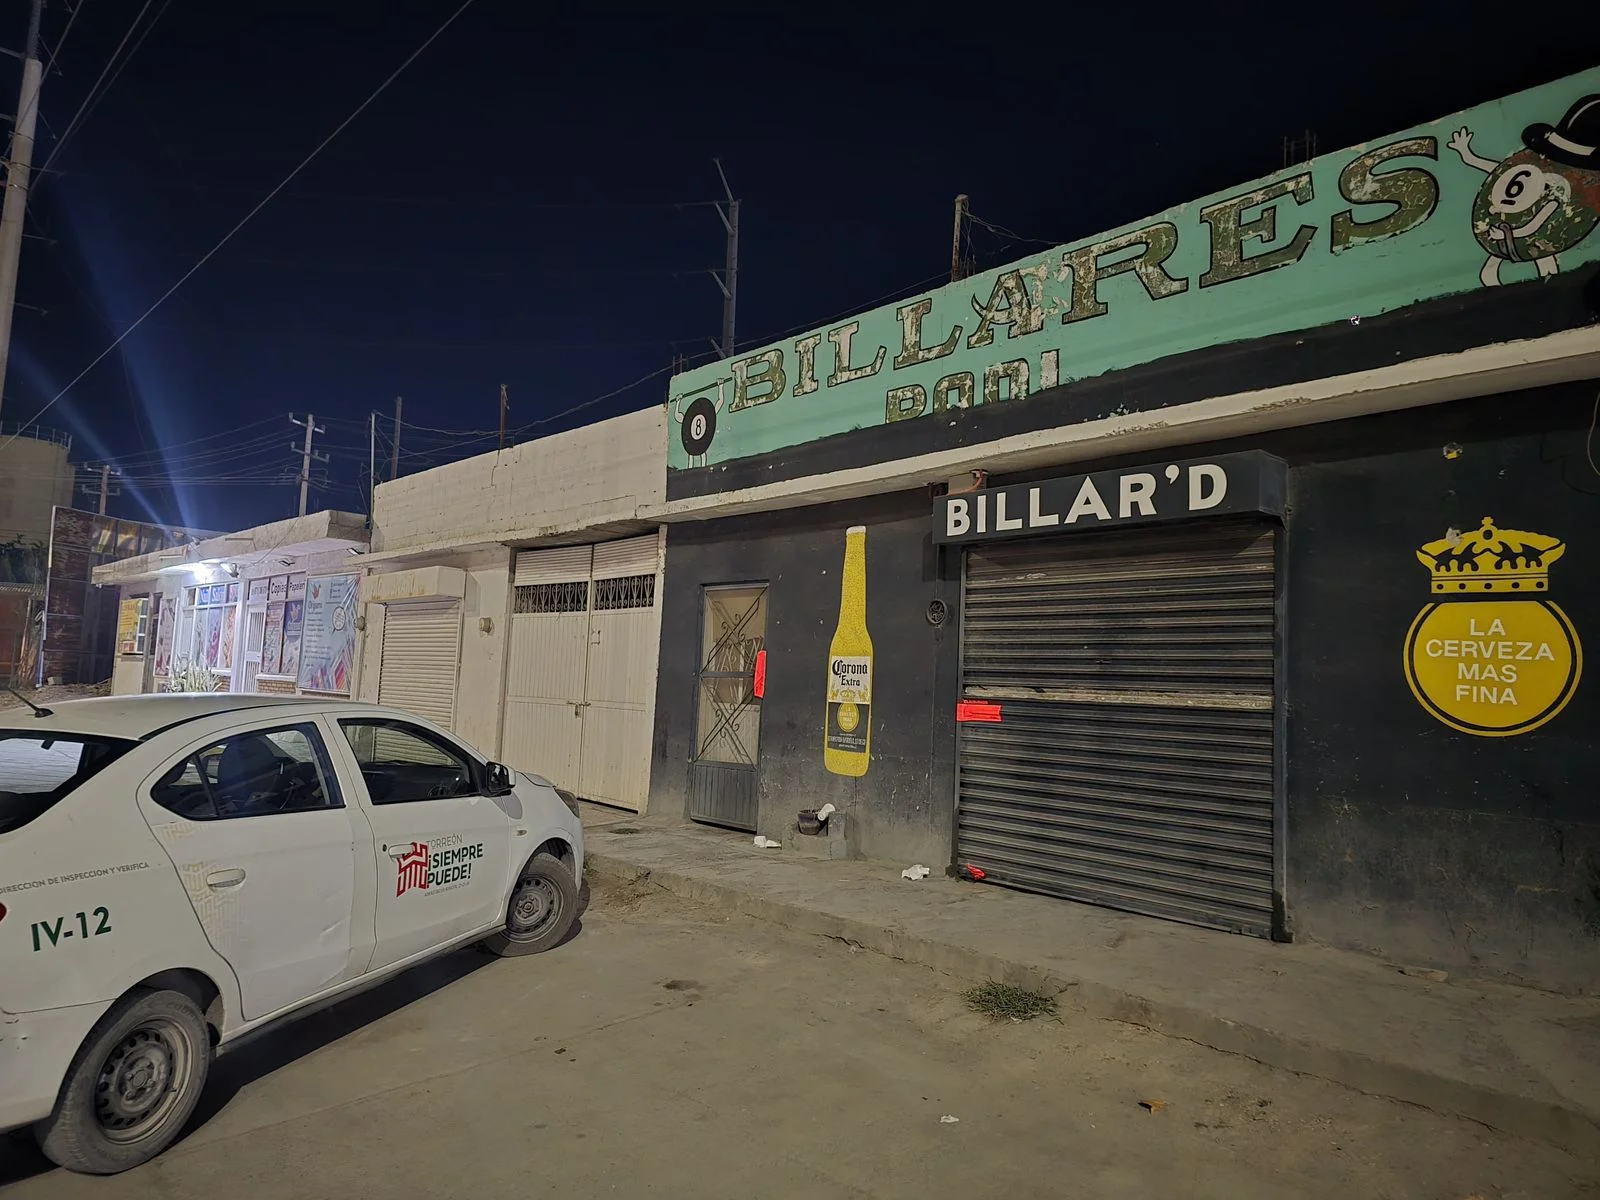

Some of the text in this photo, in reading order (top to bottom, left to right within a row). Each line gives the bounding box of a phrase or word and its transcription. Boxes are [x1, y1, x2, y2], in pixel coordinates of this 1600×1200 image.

[1505, 170, 1532, 198] 6
[728, 136, 1440, 413] BILLARES
[695, 418, 702, 436] 8
[1469, 618, 1506, 637] LA
[1426, 639, 1555, 661] CERVEZA
[831, 659, 868, 678] Corona
[1457, 662, 1518, 684] MAS
[840, 674, 861, 686] Extra
[1455, 684, 1518, 705] FINA
[47, 877, 60, 885] DE
[115, 861, 150, 873] VERIFICA
[427, 862, 472, 889] PUEDE!
[31, 906, 112, 952] IV-12
